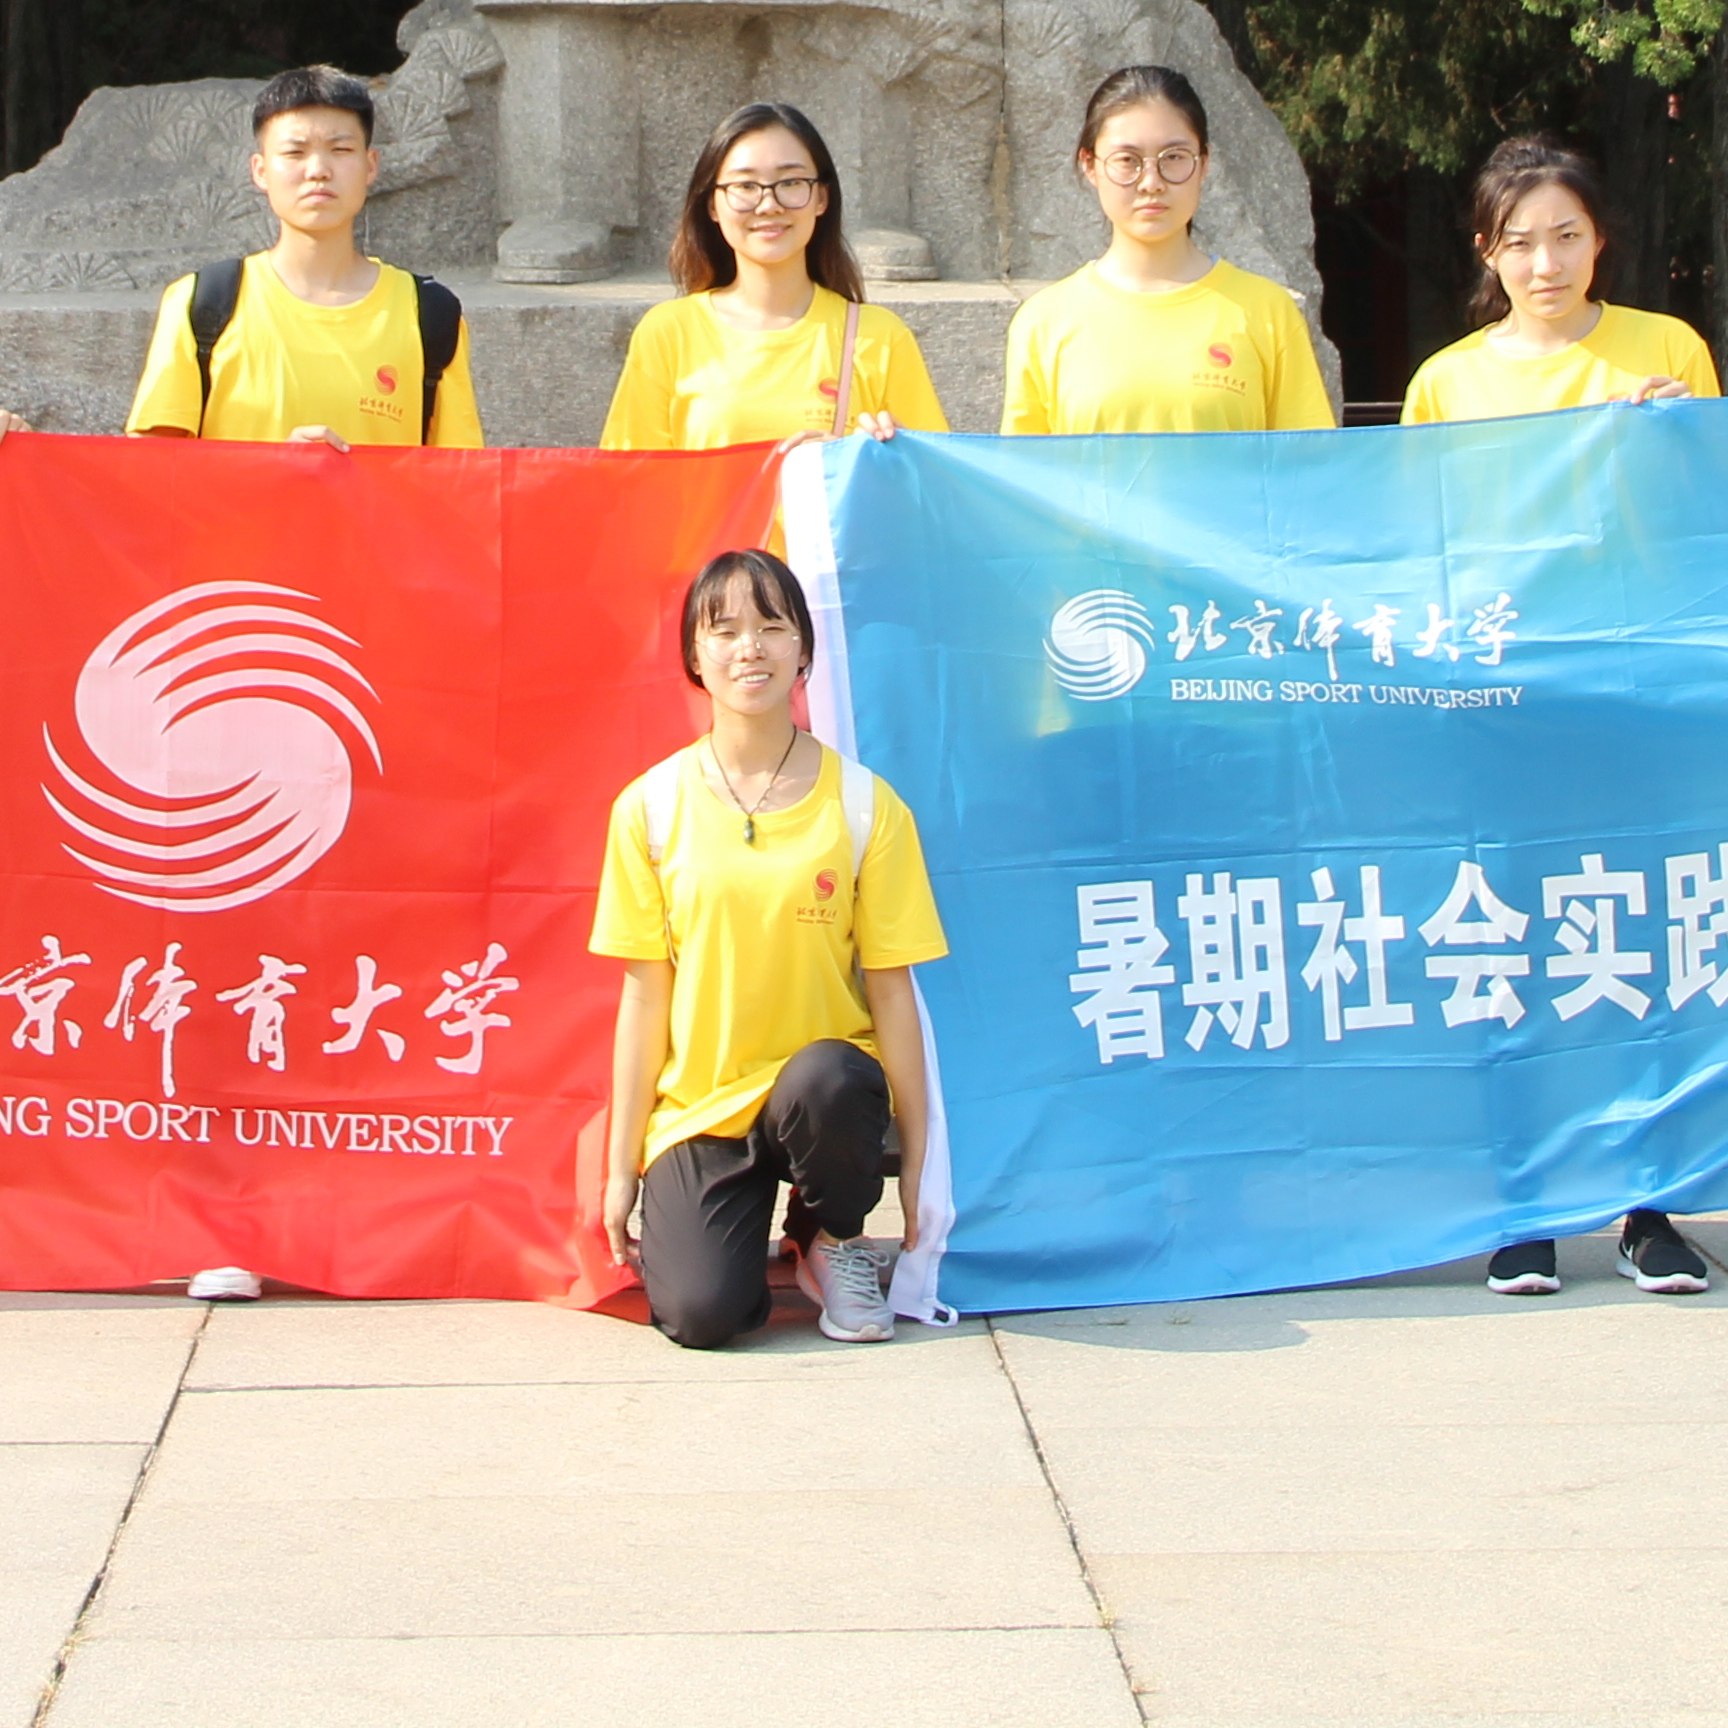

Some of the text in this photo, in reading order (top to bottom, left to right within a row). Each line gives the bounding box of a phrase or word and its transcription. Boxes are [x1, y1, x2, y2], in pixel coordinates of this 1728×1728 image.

[1167, 592, 1520, 681] 北京体育大学
[1170, 678, 1523, 709] BEIJING SPORT UNIVERSITY
[65, 1098, 221, 1145] SPORT
[232, 1108, 515, 1157] UNIVERSITY
